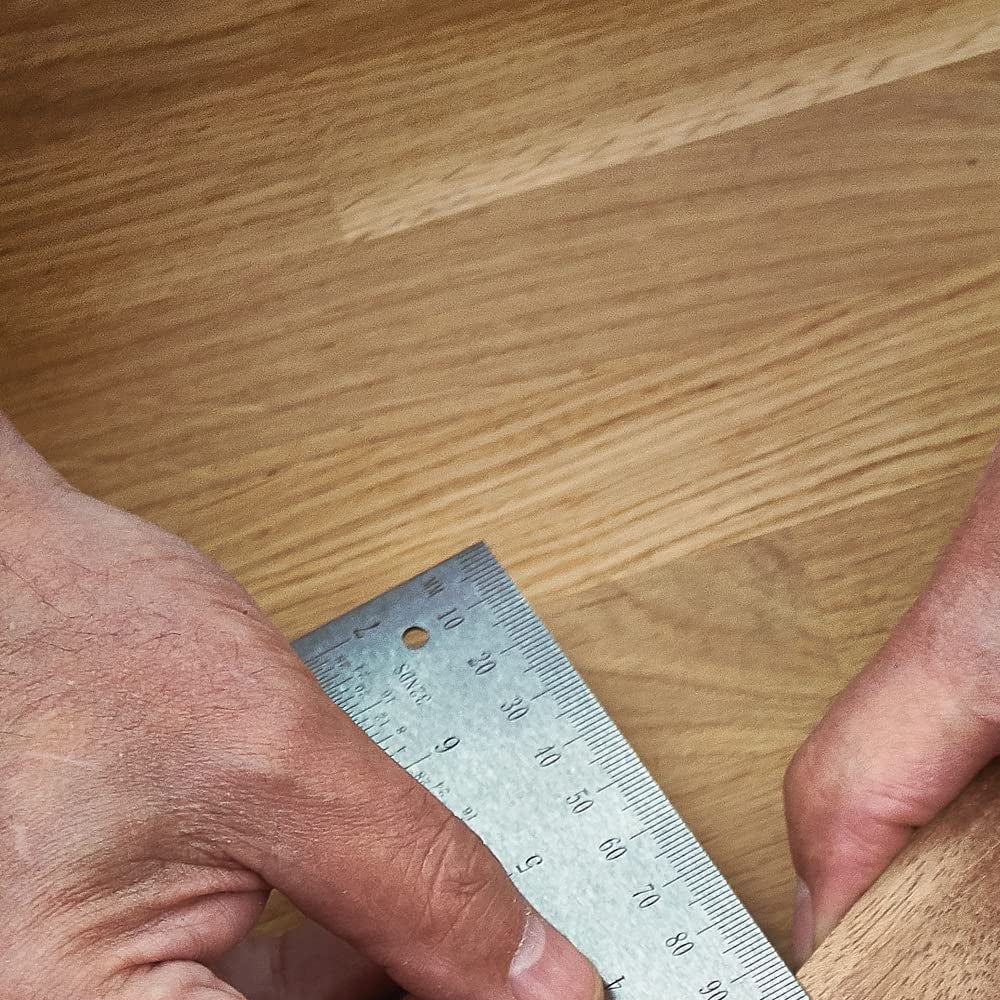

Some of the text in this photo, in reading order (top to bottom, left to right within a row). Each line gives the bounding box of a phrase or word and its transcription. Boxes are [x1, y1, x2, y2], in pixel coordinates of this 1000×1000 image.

[434, 736, 460, 753] 6
[438, 608, 465, 630] 10
[467, 652, 497, 676] 20
[500, 696, 529, 721] 30
[534, 745, 562, 768] 40
[566, 788, 594, 814] 50
[599, 837, 628, 861] 60
[632, 883, 661, 909] 70
[665, 932, 695, 957] 80
[515, 854, 543, 873] 5
[606, 975, 625, 990] 4
